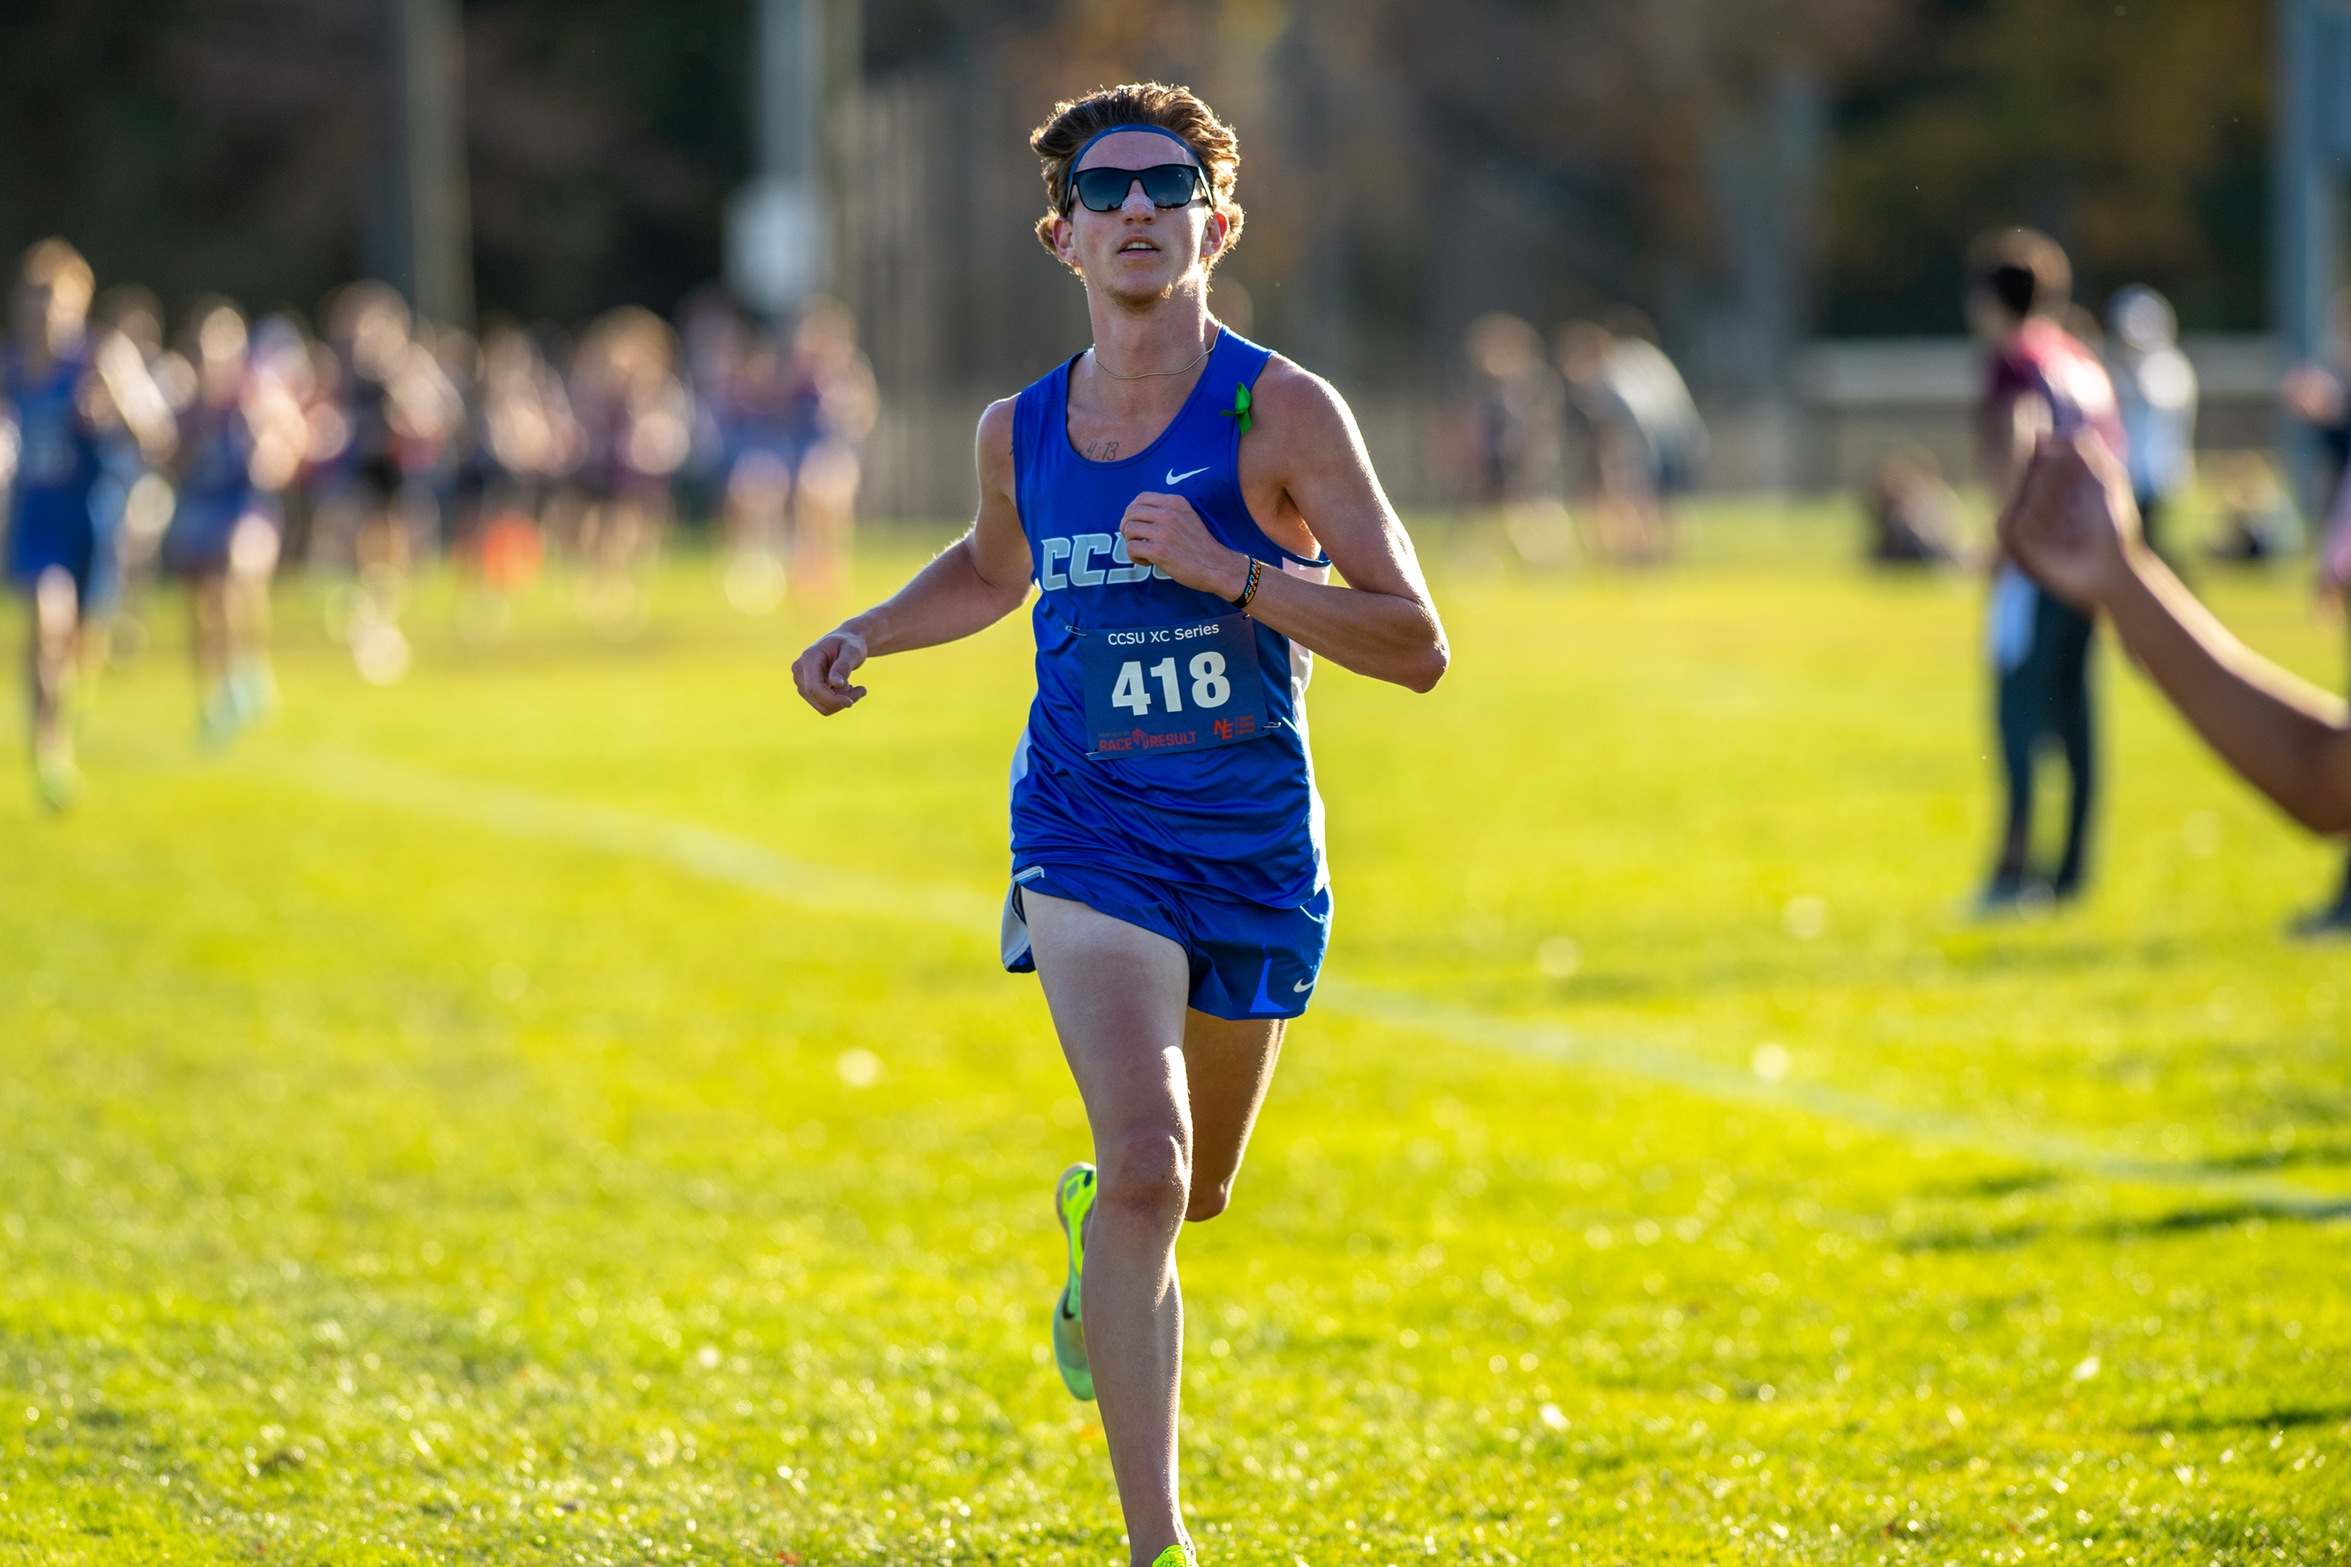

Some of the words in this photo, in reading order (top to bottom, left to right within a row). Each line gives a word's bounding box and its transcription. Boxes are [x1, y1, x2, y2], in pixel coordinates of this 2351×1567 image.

[1041, 531, 1172, 591] CCS
[1107, 632, 1145, 646] CCSU
[1150, 630, 1171, 643] XC
[1175, 623, 1220, 641] Series
[1111, 651, 1231, 716] 418
[1098, 737, 1133, 752] RACE
[1149, 731, 1196, 748] RESULT
